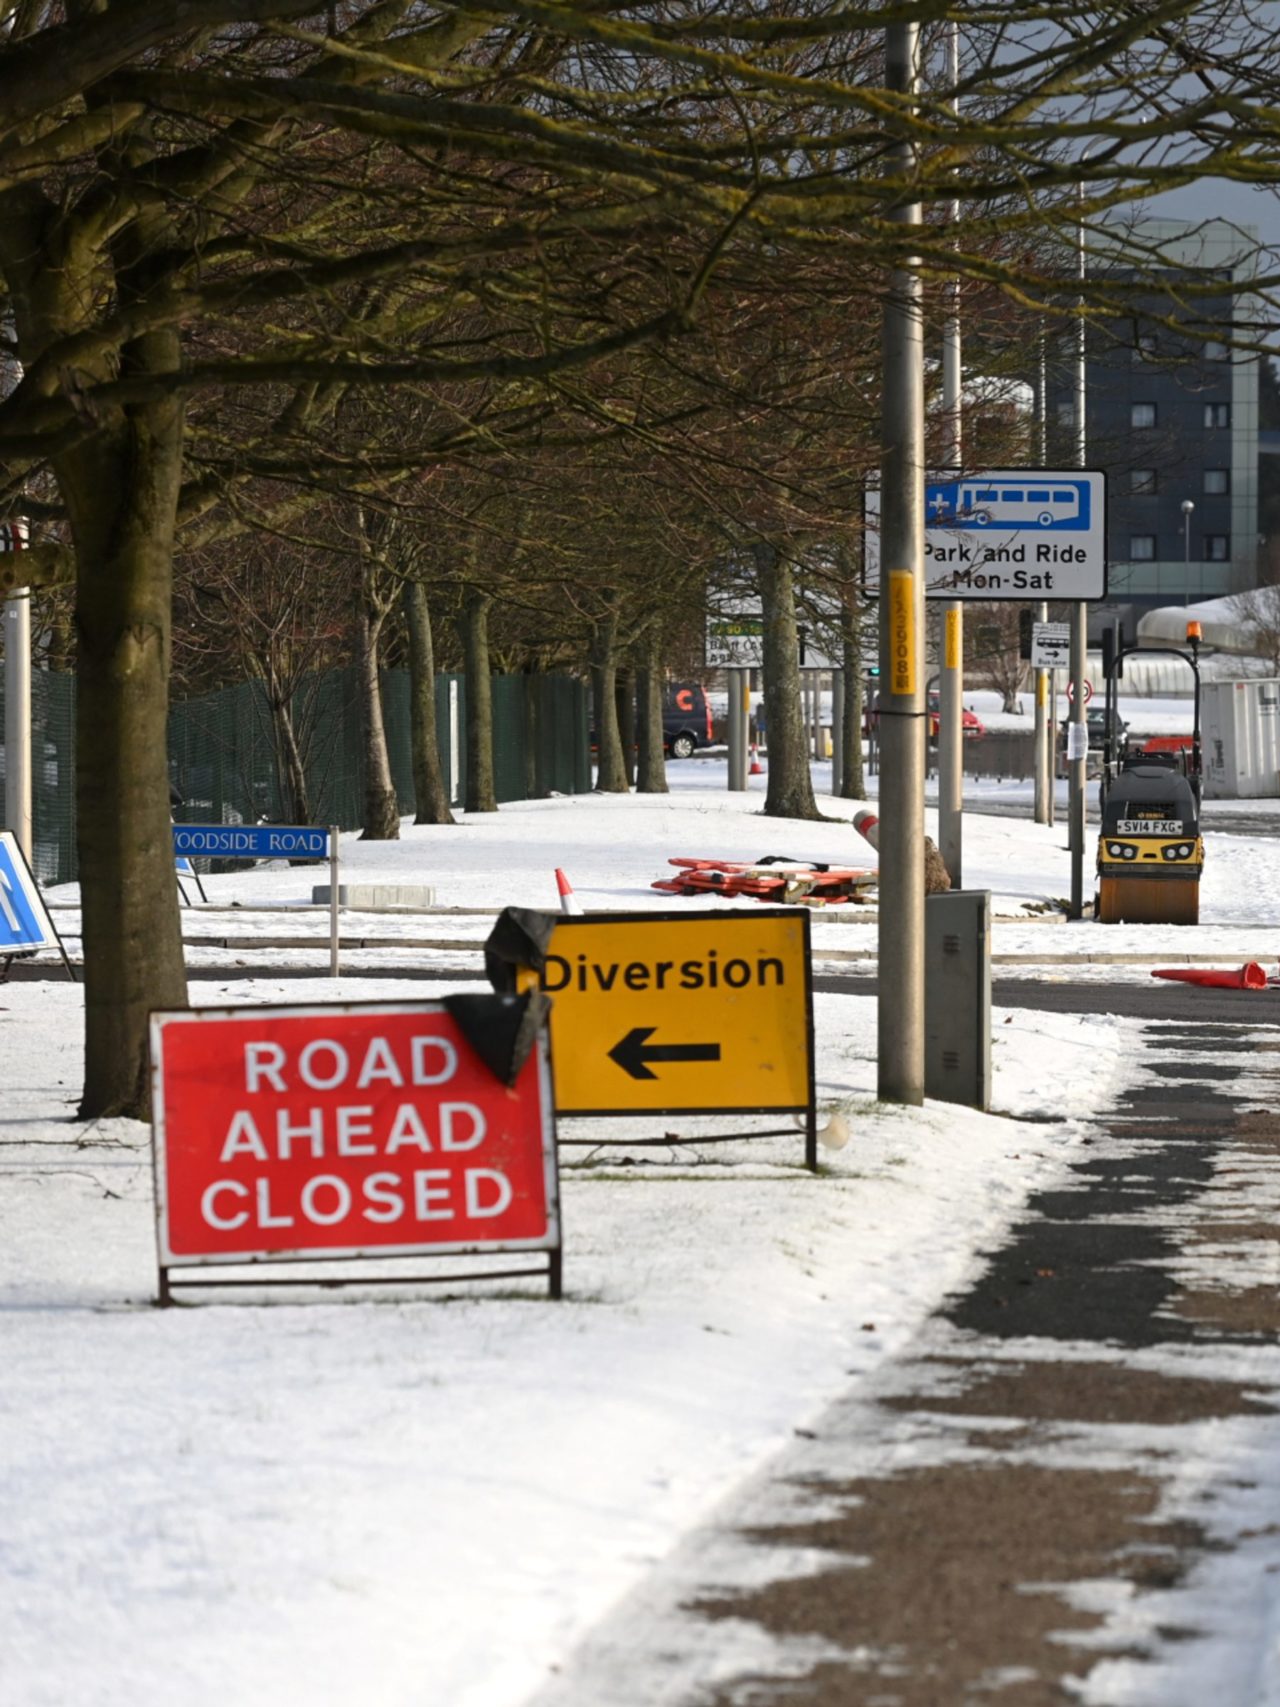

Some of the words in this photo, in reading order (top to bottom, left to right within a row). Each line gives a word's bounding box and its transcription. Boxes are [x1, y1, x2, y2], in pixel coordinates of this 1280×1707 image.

[924, 544, 971, 562] Park
[983, 544, 1025, 562] and
[1037, 544, 1087, 563] Ride
[952, 570, 1053, 589] Mon-Sat
[174, 832, 259, 850] OODSIDE
[269, 833, 324, 850] ROAD
[1124, 821, 1150, 832] SV14
[1153, 821, 1176, 832] FXG
[538, 949, 785, 993] Diversion
[244, 1035, 460, 1094] ROAD
[218, 1101, 488, 1163] AHEAD
[200, 1167, 514, 1231] CLOSED
